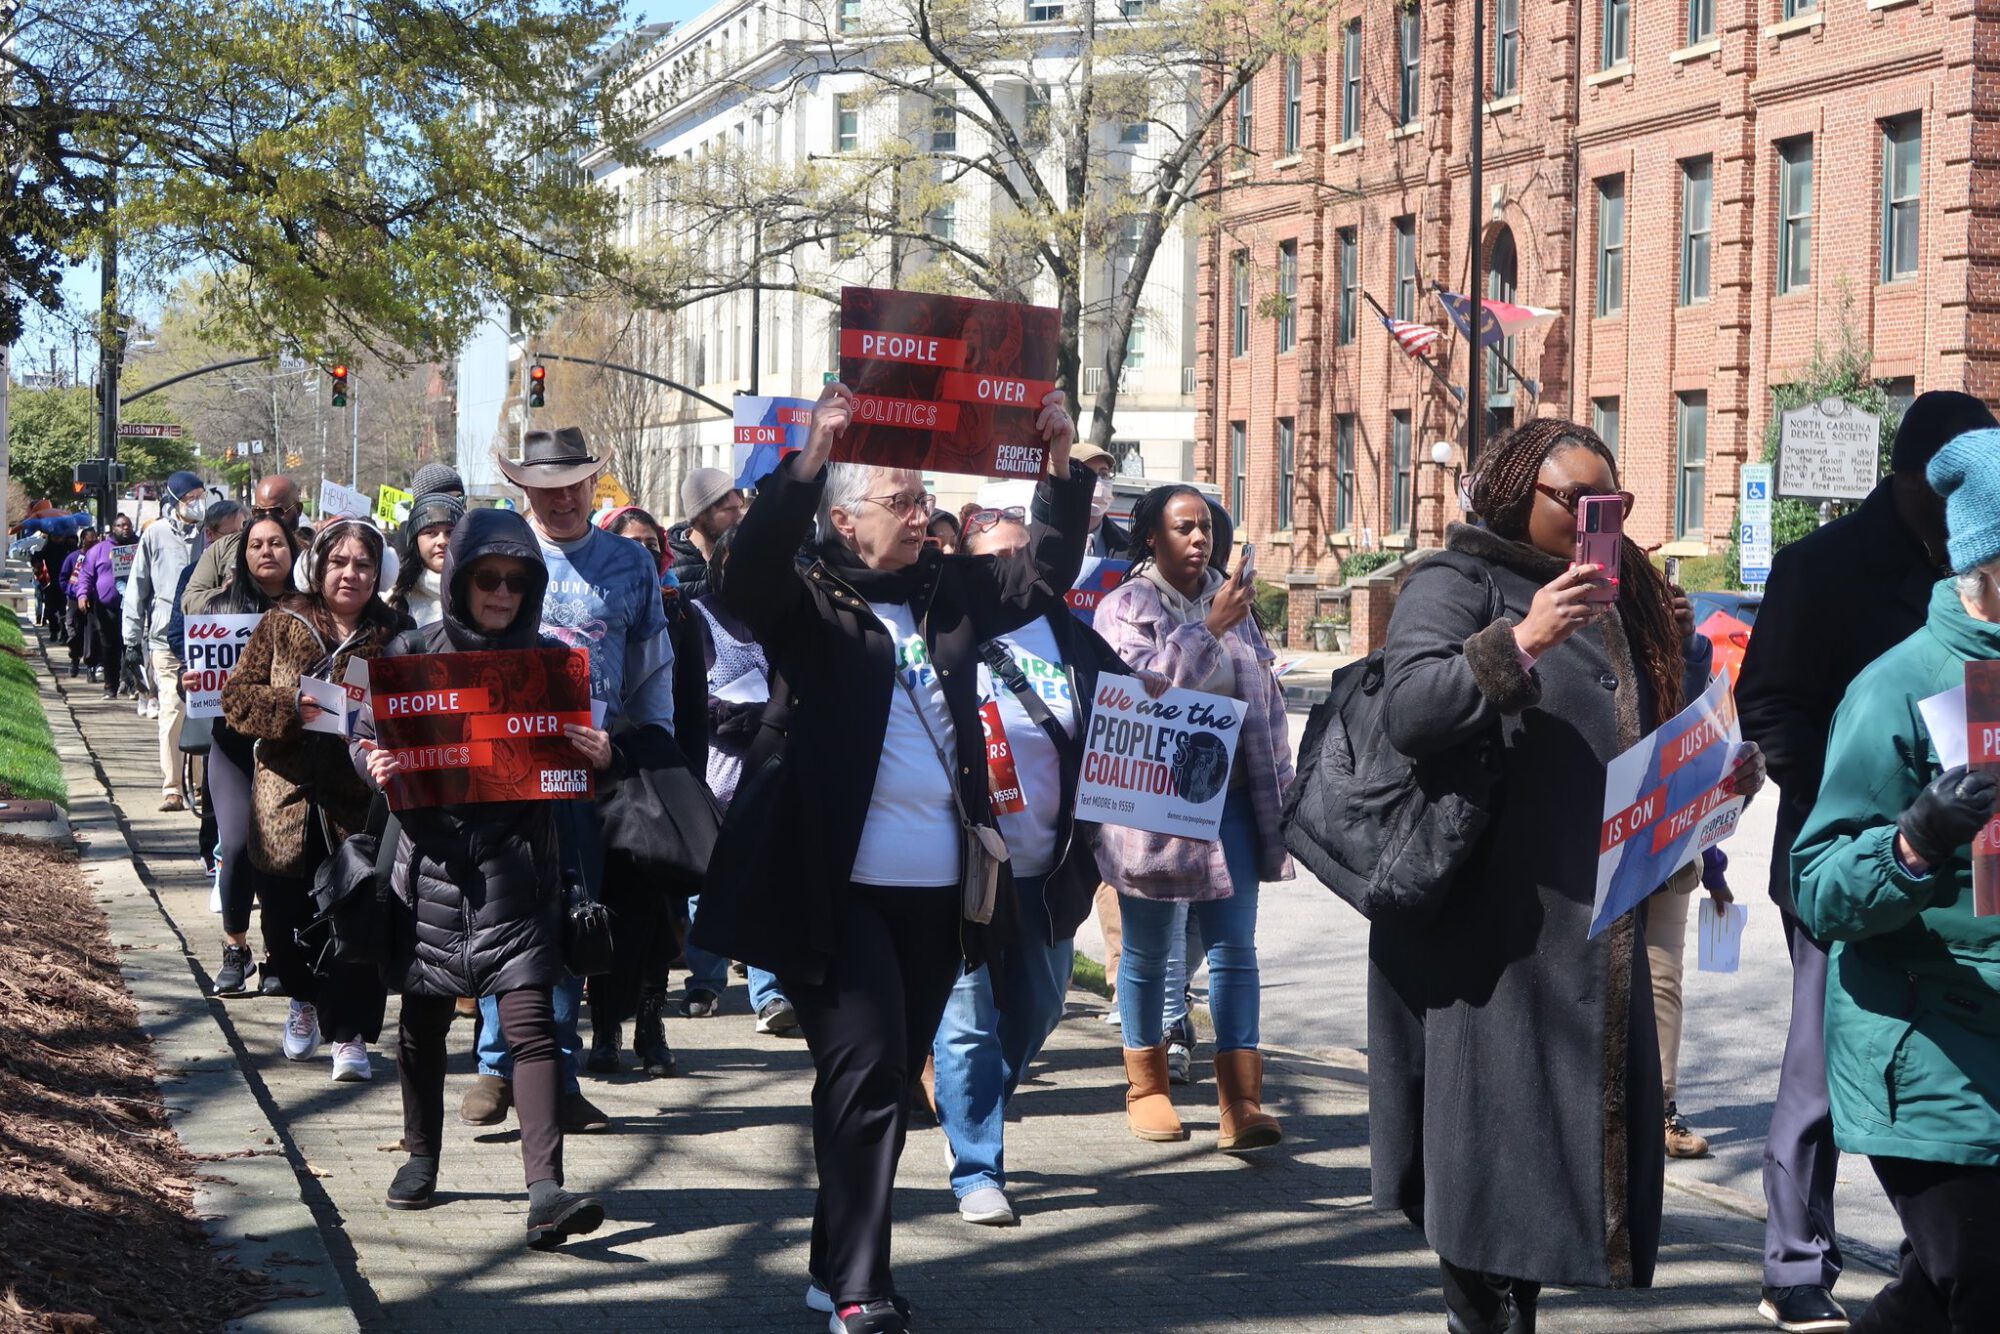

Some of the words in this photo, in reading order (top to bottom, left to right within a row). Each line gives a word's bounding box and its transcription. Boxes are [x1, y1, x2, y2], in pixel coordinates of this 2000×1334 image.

[862, 334, 938, 361] PEOPLE
[281, 360, 302, 368] ONLY
[978, 379, 1025, 402] OVER
[117, 424, 161, 437] Salisbury
[1790, 419, 1820, 429] NORTH
[1826, 421, 1871, 432] CAROLINA
[740, 429, 750, 441] IS
[757, 429, 775, 441] ON
[1791, 430, 1826, 440] DENTAL
[1832, 432, 1871, 443] SOCIETY
[997, 444, 1043, 462] PEOPLE'S
[1784, 445, 1828, 456] Organized
[995, 459, 1041, 474] COALITION
[1784, 463, 1808, 472] which
[1819, 465, 1842, 474] stood
[1743, 526, 1752, 542] 2
[550, 580, 610, 600] OUNTRY
[1074, 592, 1095, 607] ON
[188, 622, 231, 639] We
[347, 686, 362, 700] IS
[388, 692, 459, 715] PEOPLE
[1097, 685, 1134, 711] We
[1136, 699, 1183, 720] are
[1187, 702, 1237, 730] the
[507, 715, 558, 734] OVER
[1089, 714, 1191, 766] PEOPLE'S
[388, 746, 470, 769] OLITICS
[540, 769, 587, 783] PEOPLE'S
[1084, 751, 1183, 797] COALITION
[541, 780, 587, 793] COALITION
[993, 788, 1018, 803] 95559
[1080, 793, 1091, 806] Text
[1092, 796, 1111, 809] MOORE
[1119, 800, 1135, 813] 95559
[1608, 817, 1622, 845] IS
[1631, 797, 1654, 829] ON
[1670, 804, 1697, 838] THE
